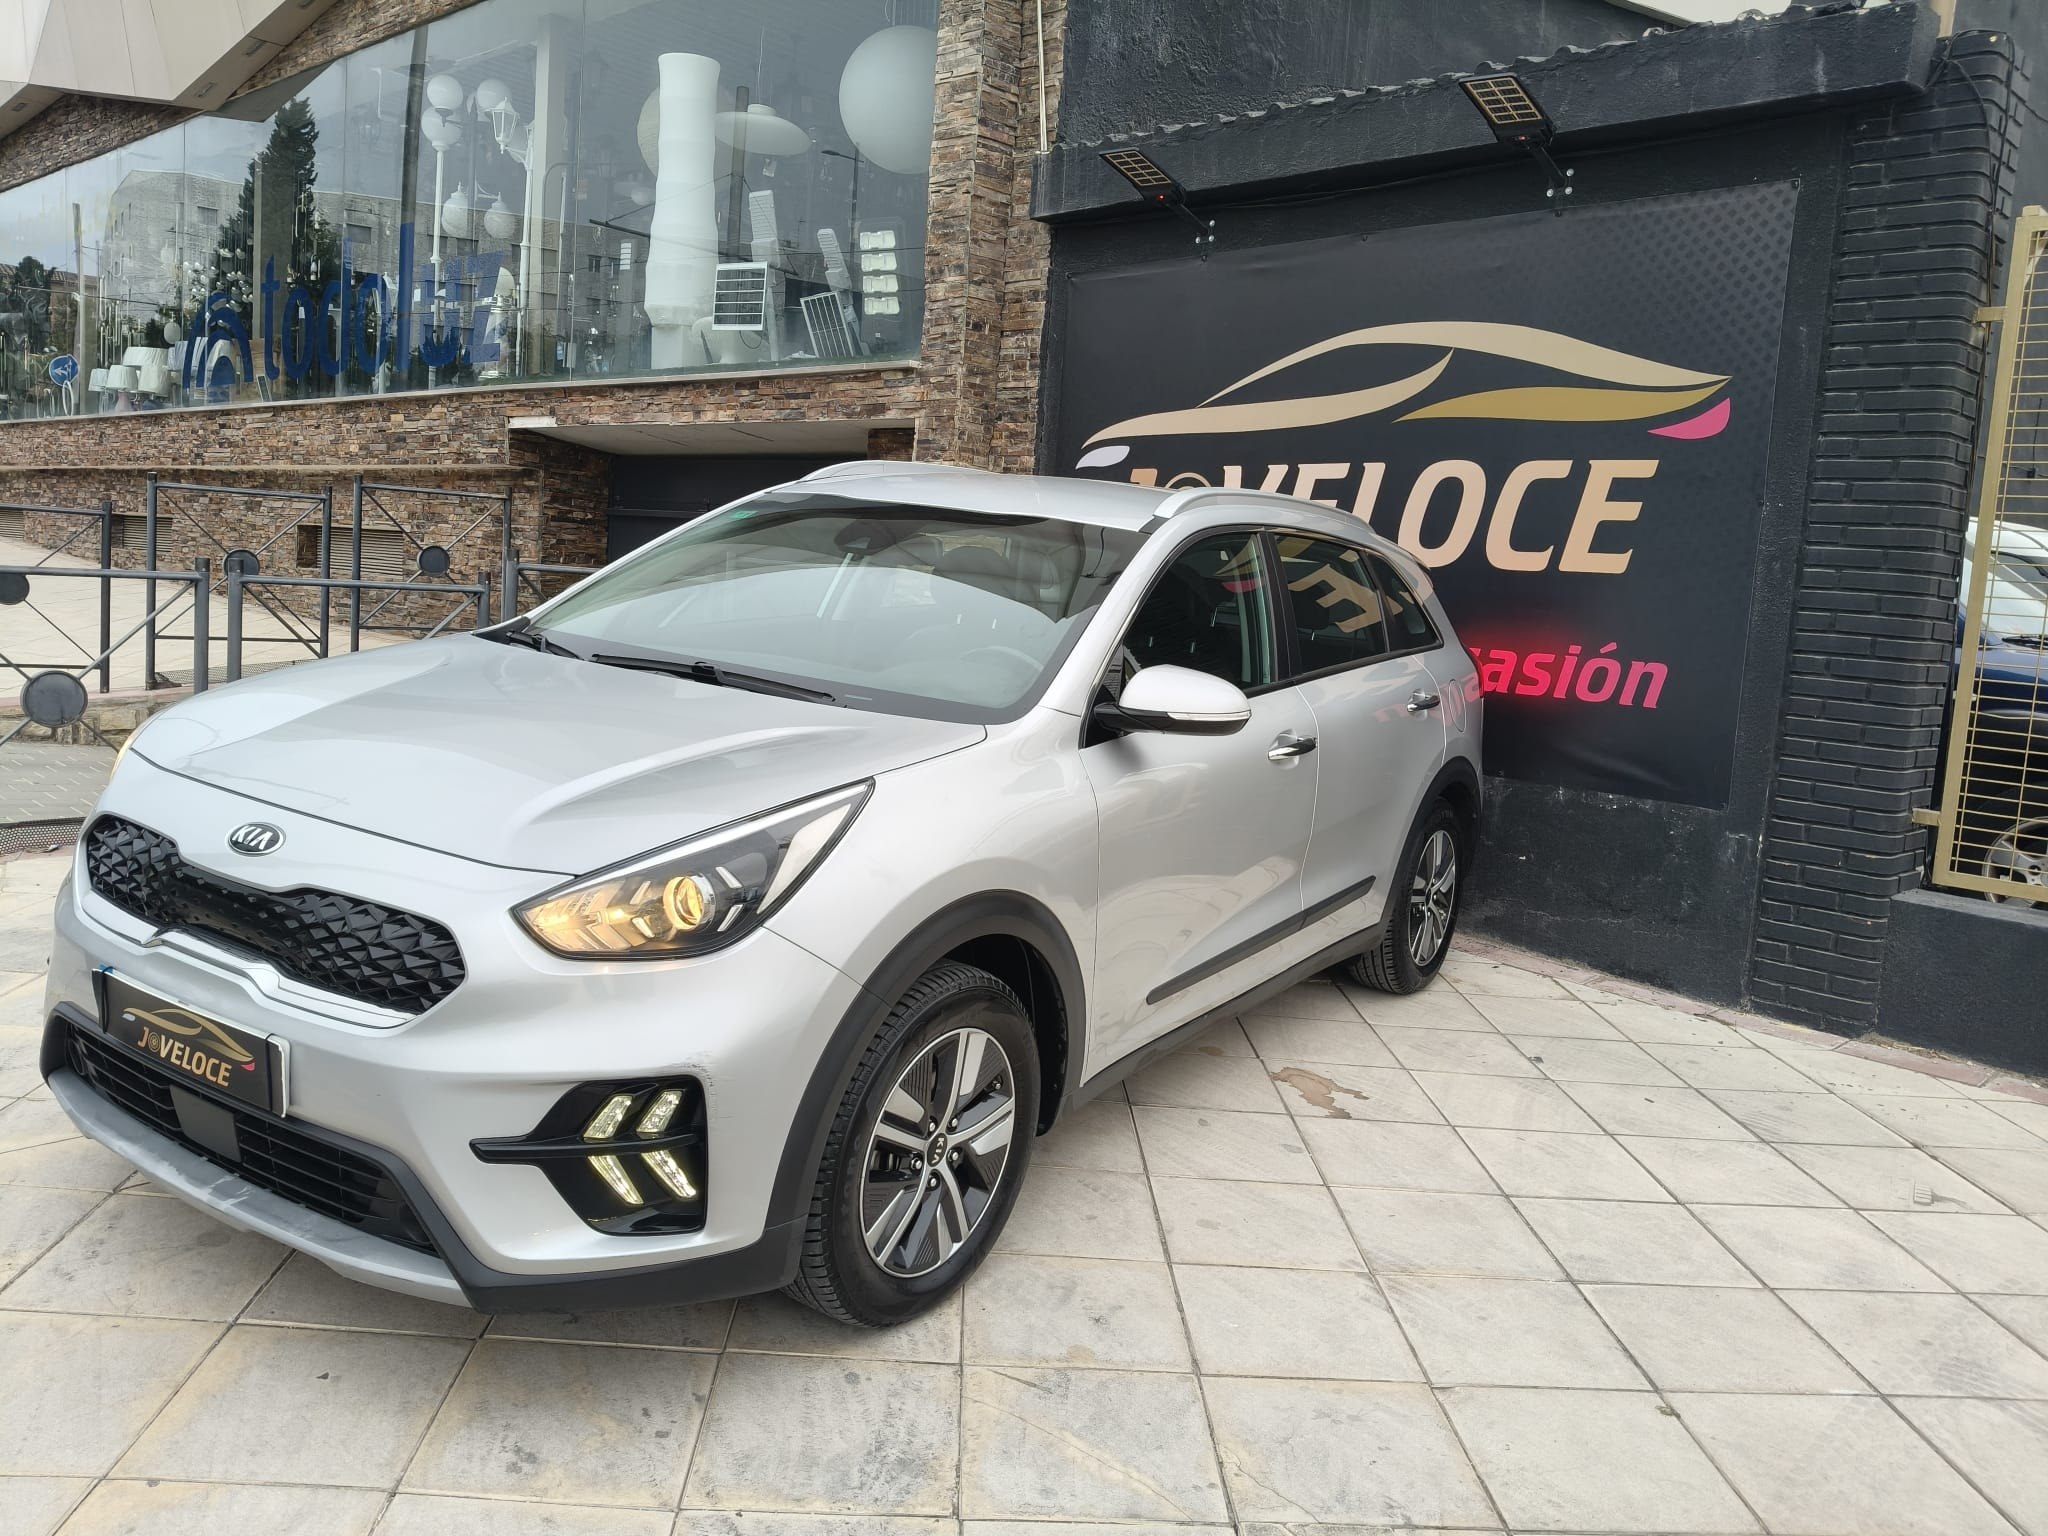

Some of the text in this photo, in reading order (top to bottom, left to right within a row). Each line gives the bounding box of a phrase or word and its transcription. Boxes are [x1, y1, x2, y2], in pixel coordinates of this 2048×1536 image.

[261, 222, 504, 381] todoluz
[1129, 459, 1660, 574] LOCE
[1469, 641, 1669, 709] asión
[231, 825, 274, 850] KIA
[931, 1137, 945, 1164] KIA
